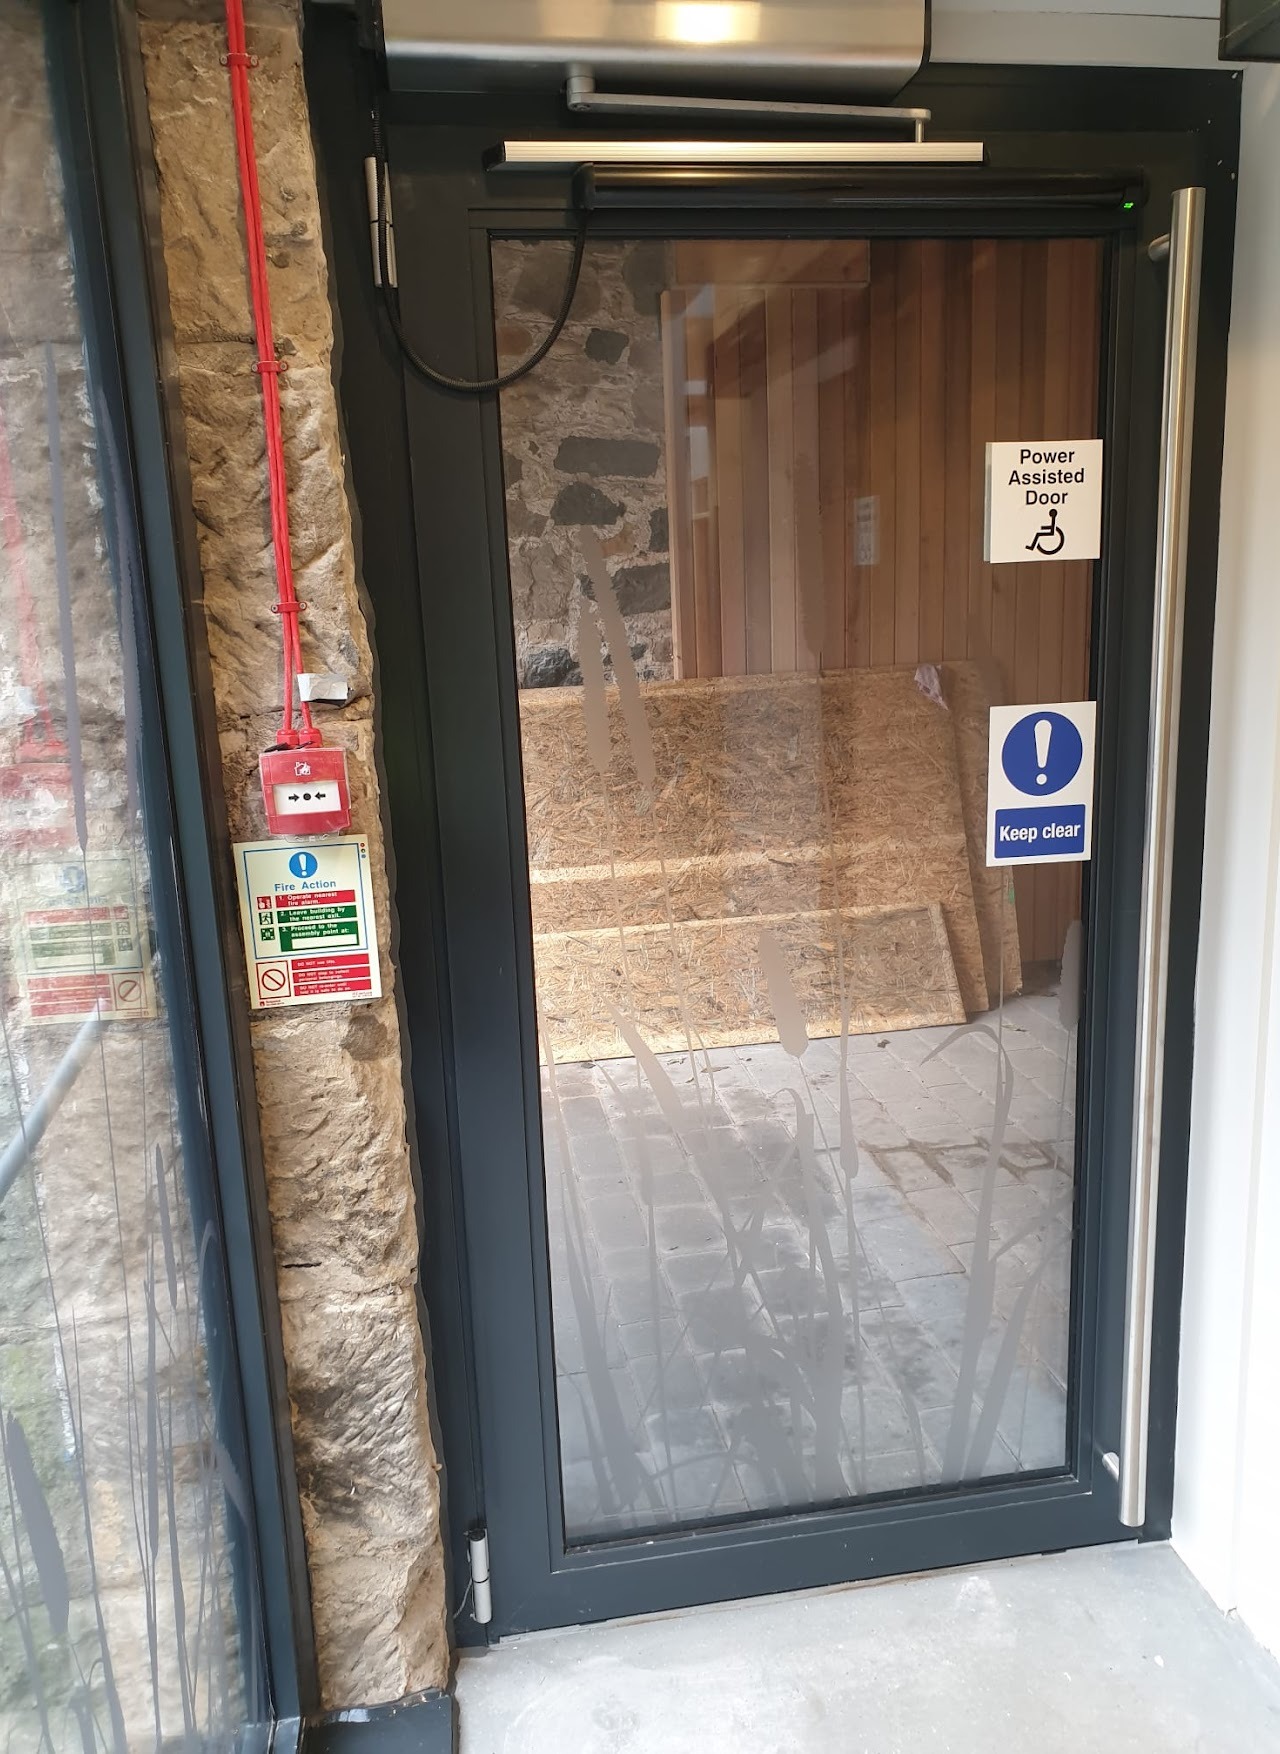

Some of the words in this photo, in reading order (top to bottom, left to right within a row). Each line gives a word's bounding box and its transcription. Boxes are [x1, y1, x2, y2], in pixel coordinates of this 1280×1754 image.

[1020, 449, 1075, 464] Power
[1009, 468, 1084, 485] Assisted
[1026, 490, 1068, 505] Door
[1000, 825, 1038, 843] Keep
[1042, 823, 1081, 838] clear
[274, 883, 296, 892] Fire
[302, 880, 336, 890] Action
[310, 907, 335, 915] building
[290, 924, 317, 932] Proceed
[291, 930, 321, 938] assembly
[322, 928, 339, 936] point
